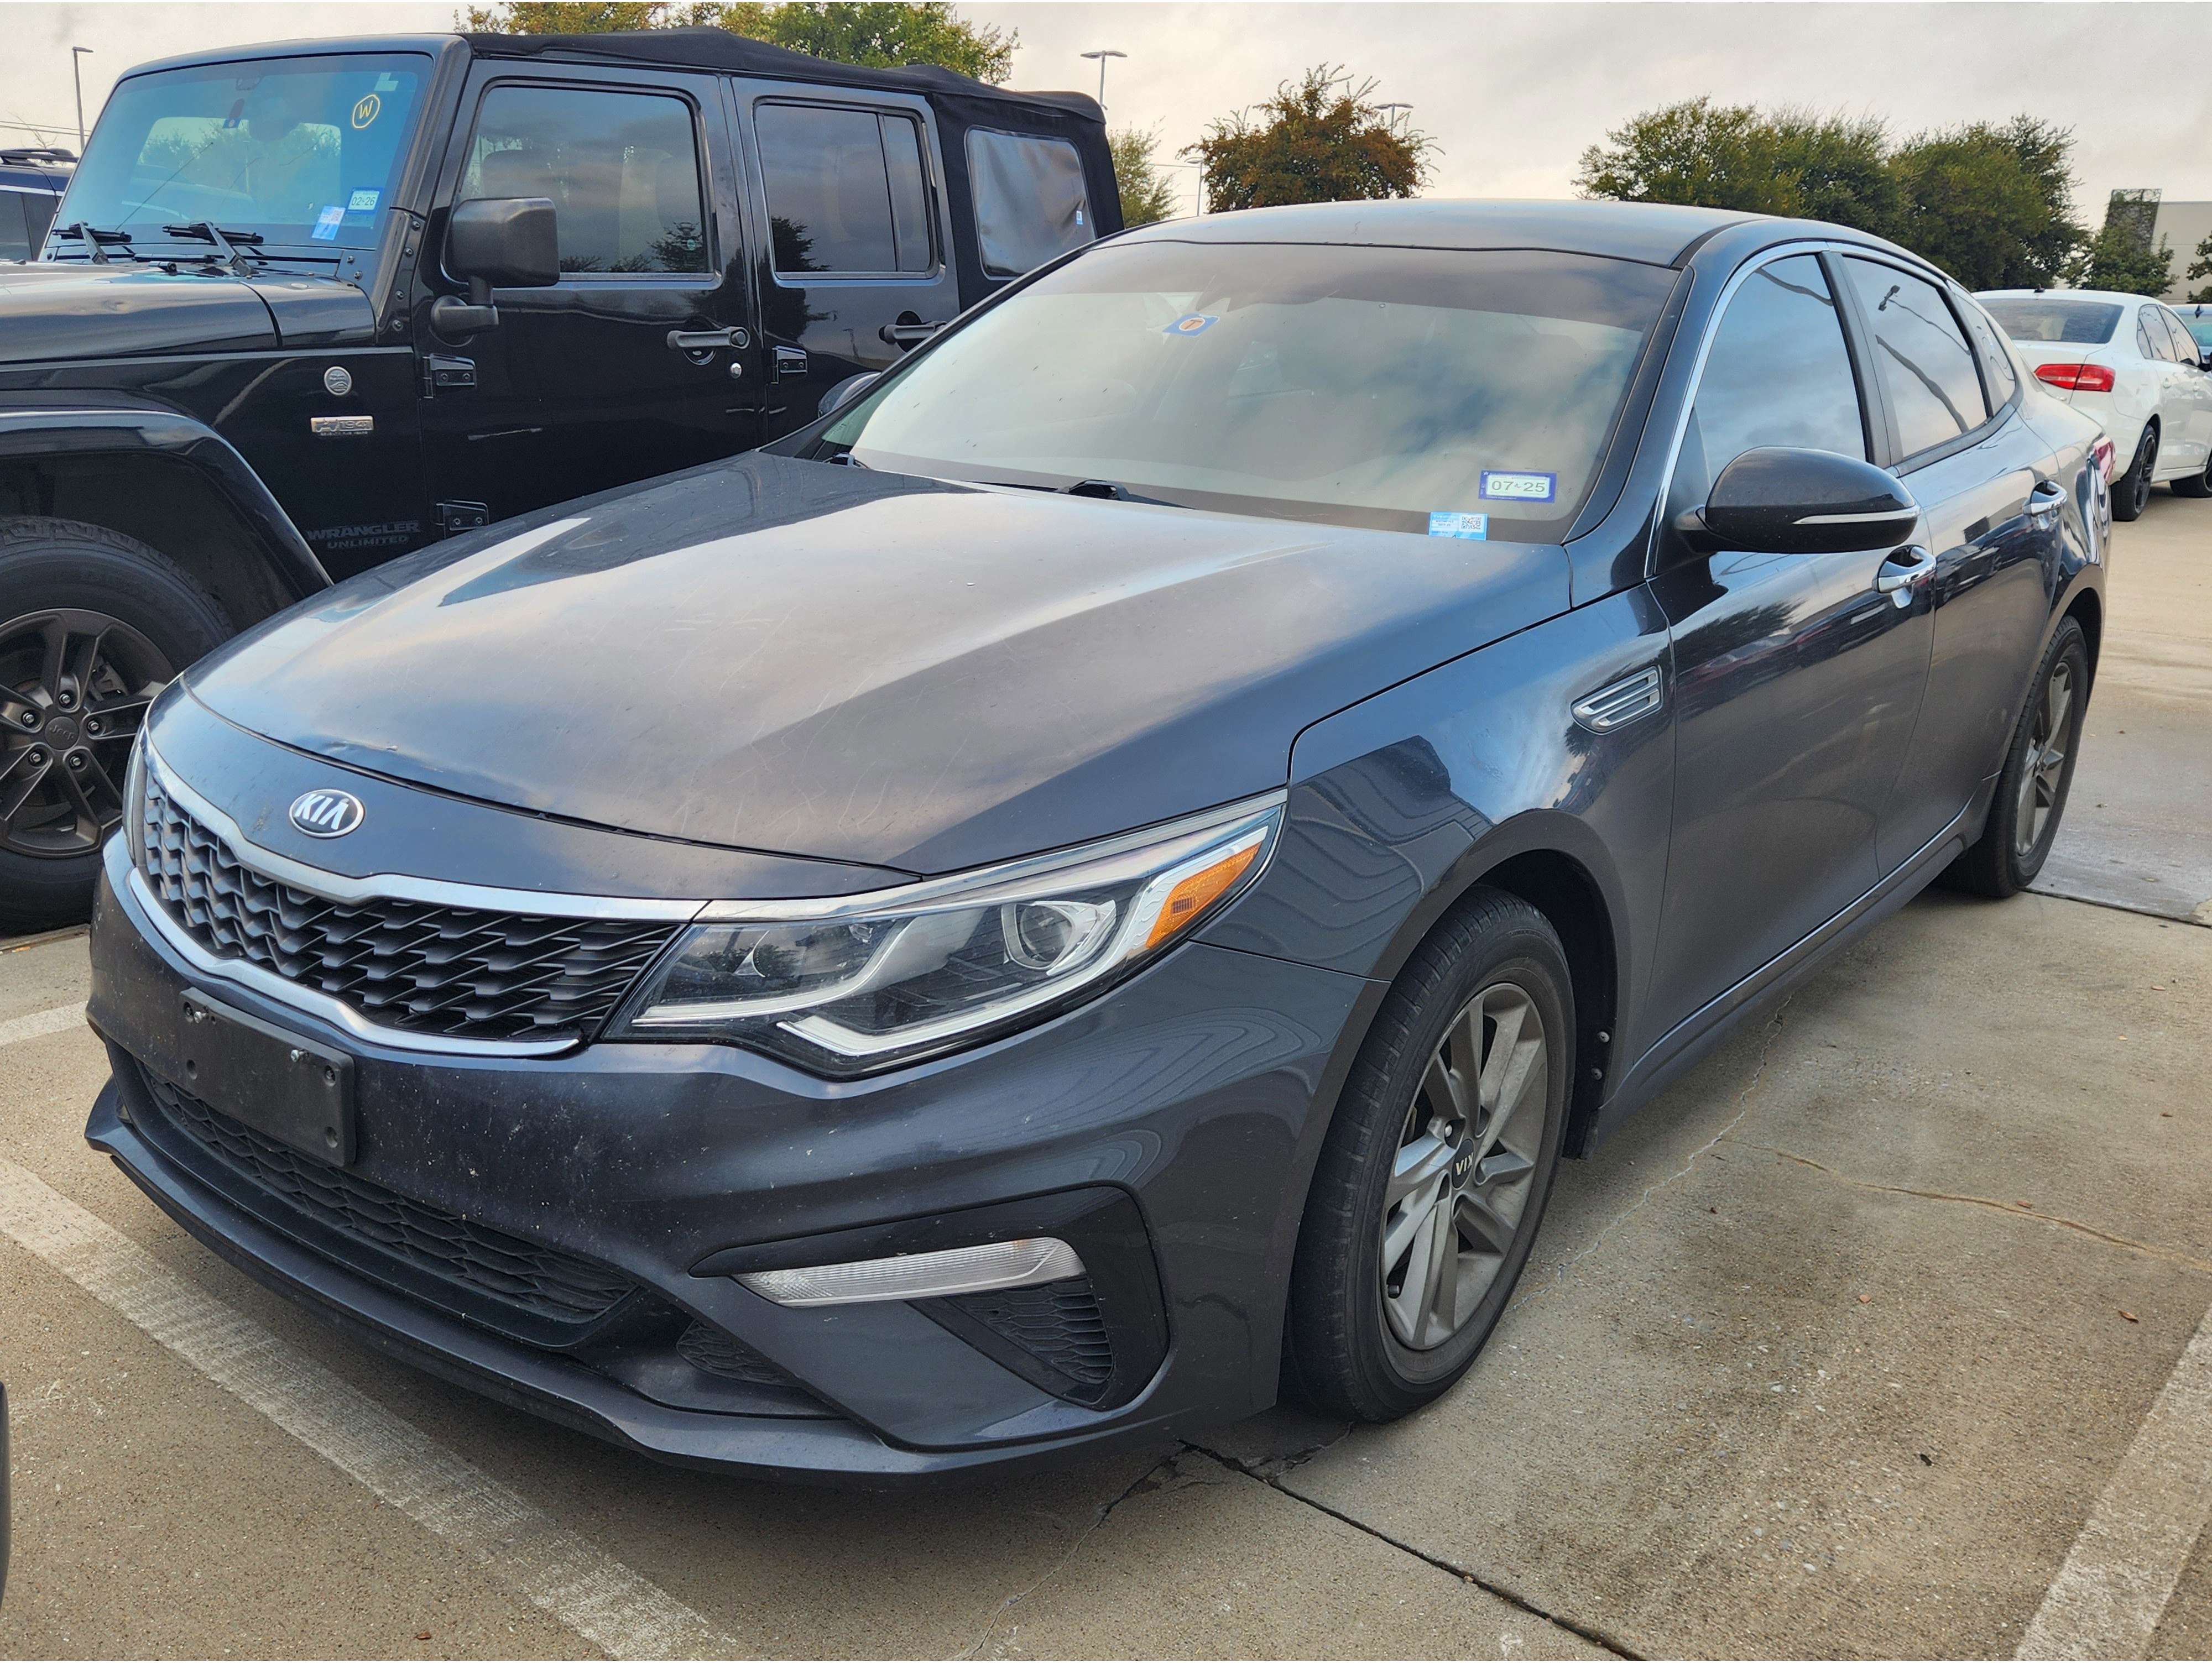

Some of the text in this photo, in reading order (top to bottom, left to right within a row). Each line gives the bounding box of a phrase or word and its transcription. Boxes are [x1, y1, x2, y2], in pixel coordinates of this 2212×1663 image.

[359, 100, 374, 119] W
[307, 522, 420, 540] WRANGLER
[327, 535, 409, 548] UNLIMITED
[49, 725, 76, 740] Jeep
[294, 793, 349, 830] KIA
